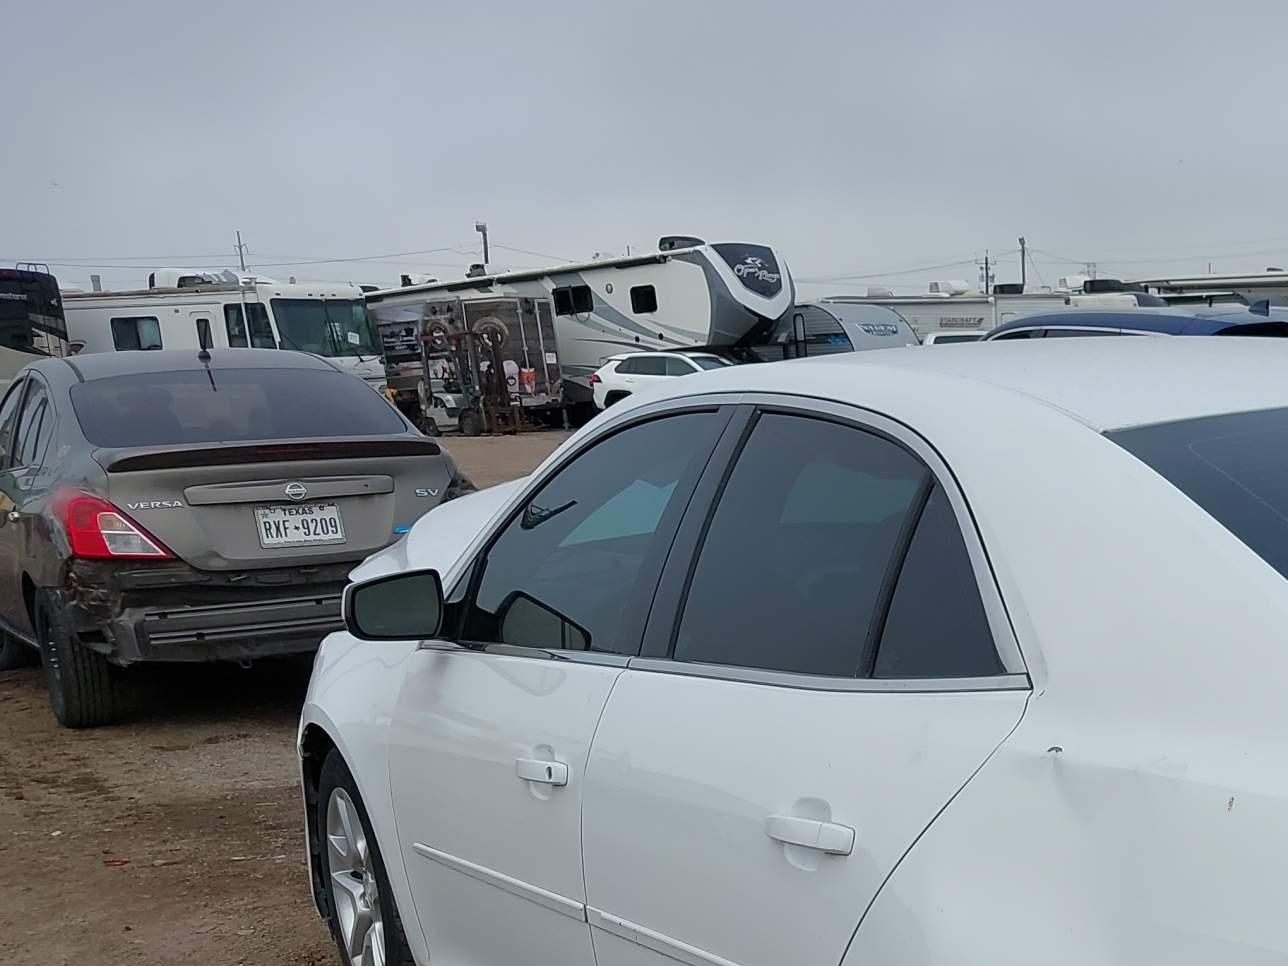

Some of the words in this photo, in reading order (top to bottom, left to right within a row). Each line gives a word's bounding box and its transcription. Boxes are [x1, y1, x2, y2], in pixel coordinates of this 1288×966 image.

[415, 488, 439, 497] SV
[127, 500, 183, 510] VERSA
[281, 506, 314, 517] TEXAS
[263, 519, 290, 539] RXF
[301, 517, 339, 537] 9209
